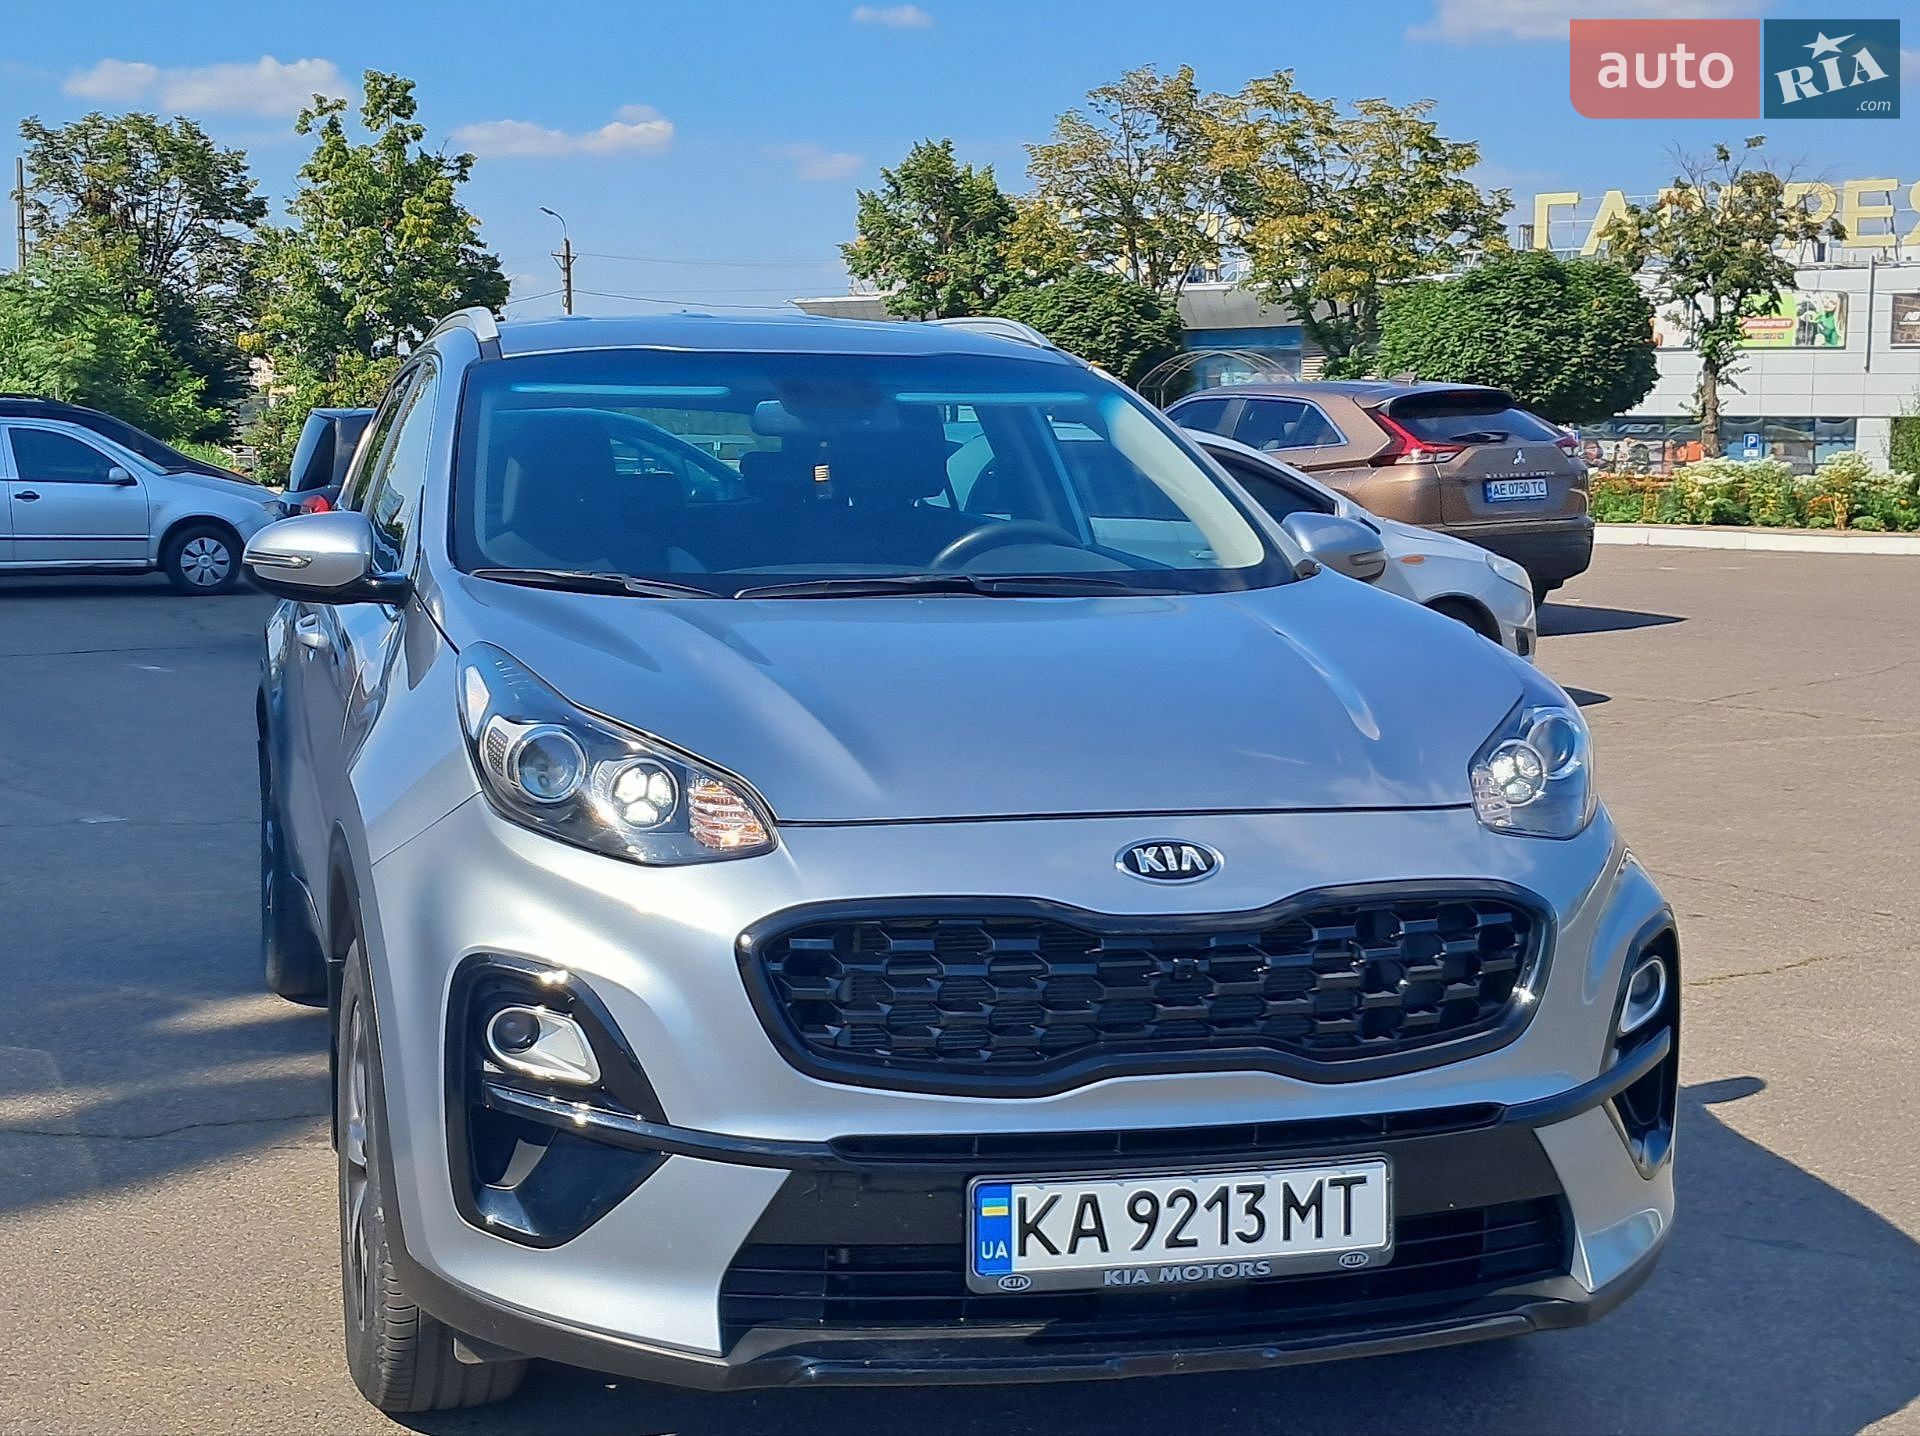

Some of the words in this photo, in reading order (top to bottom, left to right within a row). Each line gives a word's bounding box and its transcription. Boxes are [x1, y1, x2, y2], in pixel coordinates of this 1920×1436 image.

[1747, 436, 1756, 448] P
[1493, 483, 1506, 496] AE
[1131, 845, 1208, 873] KIA
[1017, 1193, 1109, 1257] KA
[1126, 1183, 1266, 1251] 9213
[1282, 1175, 1368, 1242] MT
[981, 1240, 1008, 1259] UA
[1343, 1255, 1364, 1265] KIA
[1103, 1269, 1149, 1286] KIA
[1158, 1260, 1272, 1283] MOTORS
[1003, 1277, 1026, 1288] KIA
